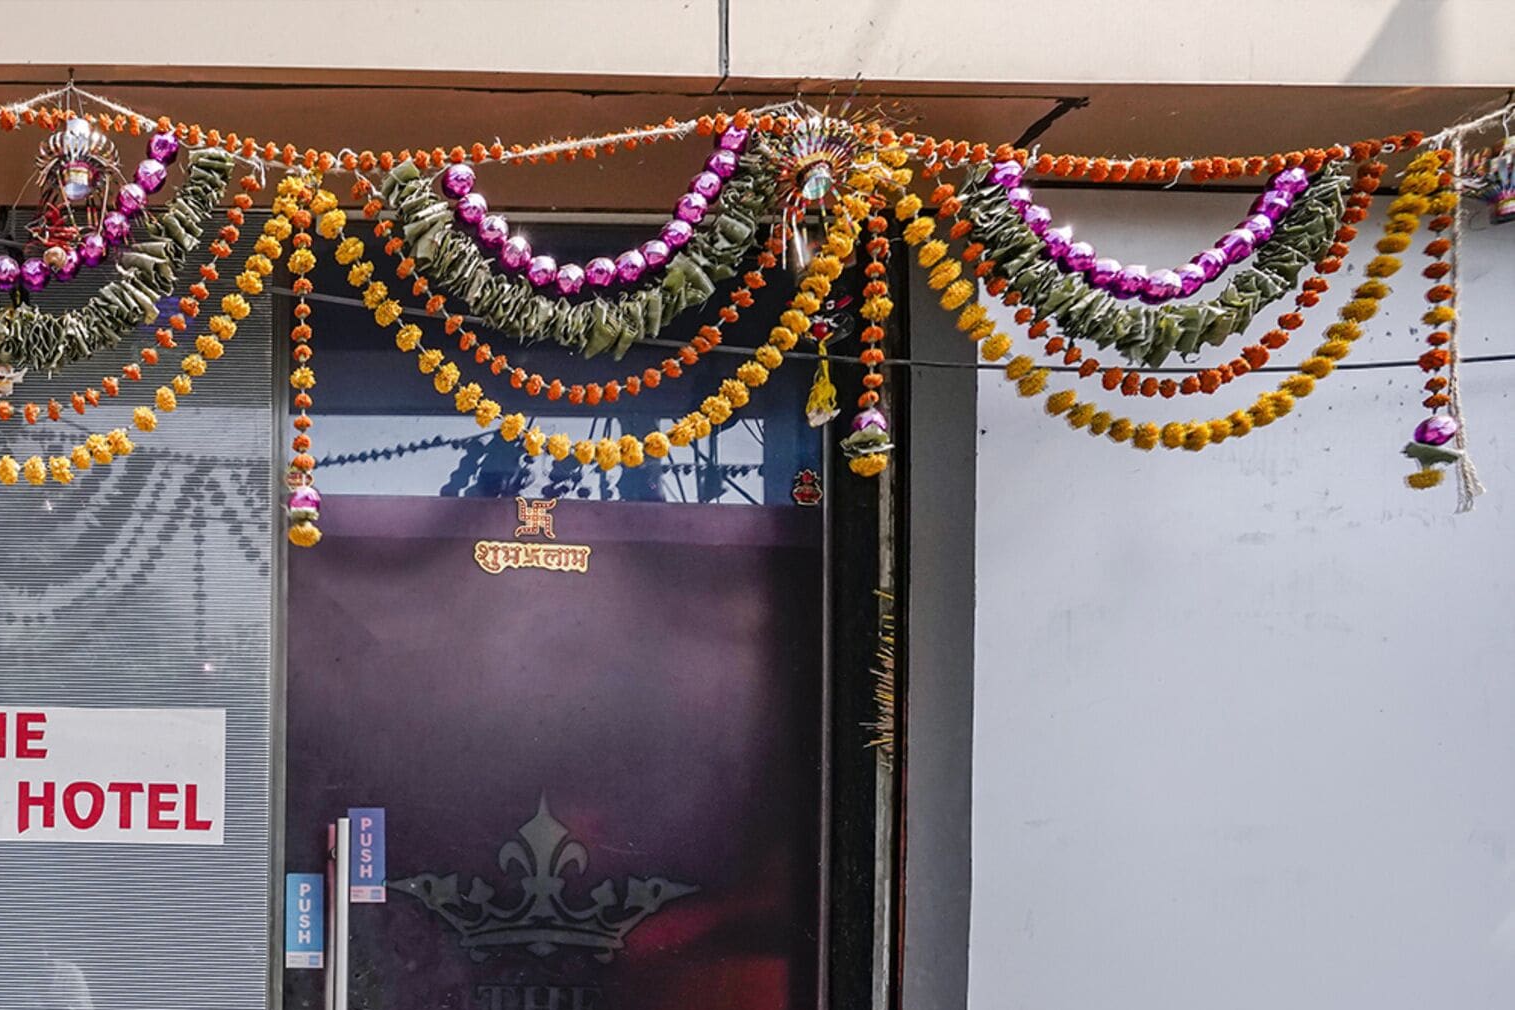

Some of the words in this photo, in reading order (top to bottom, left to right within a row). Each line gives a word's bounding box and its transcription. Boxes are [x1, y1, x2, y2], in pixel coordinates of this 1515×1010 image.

[17, 780, 214, 834] HOTEL
[359, 817, 373, 879] PUSH
[297, 883, 311, 944] PUSH
